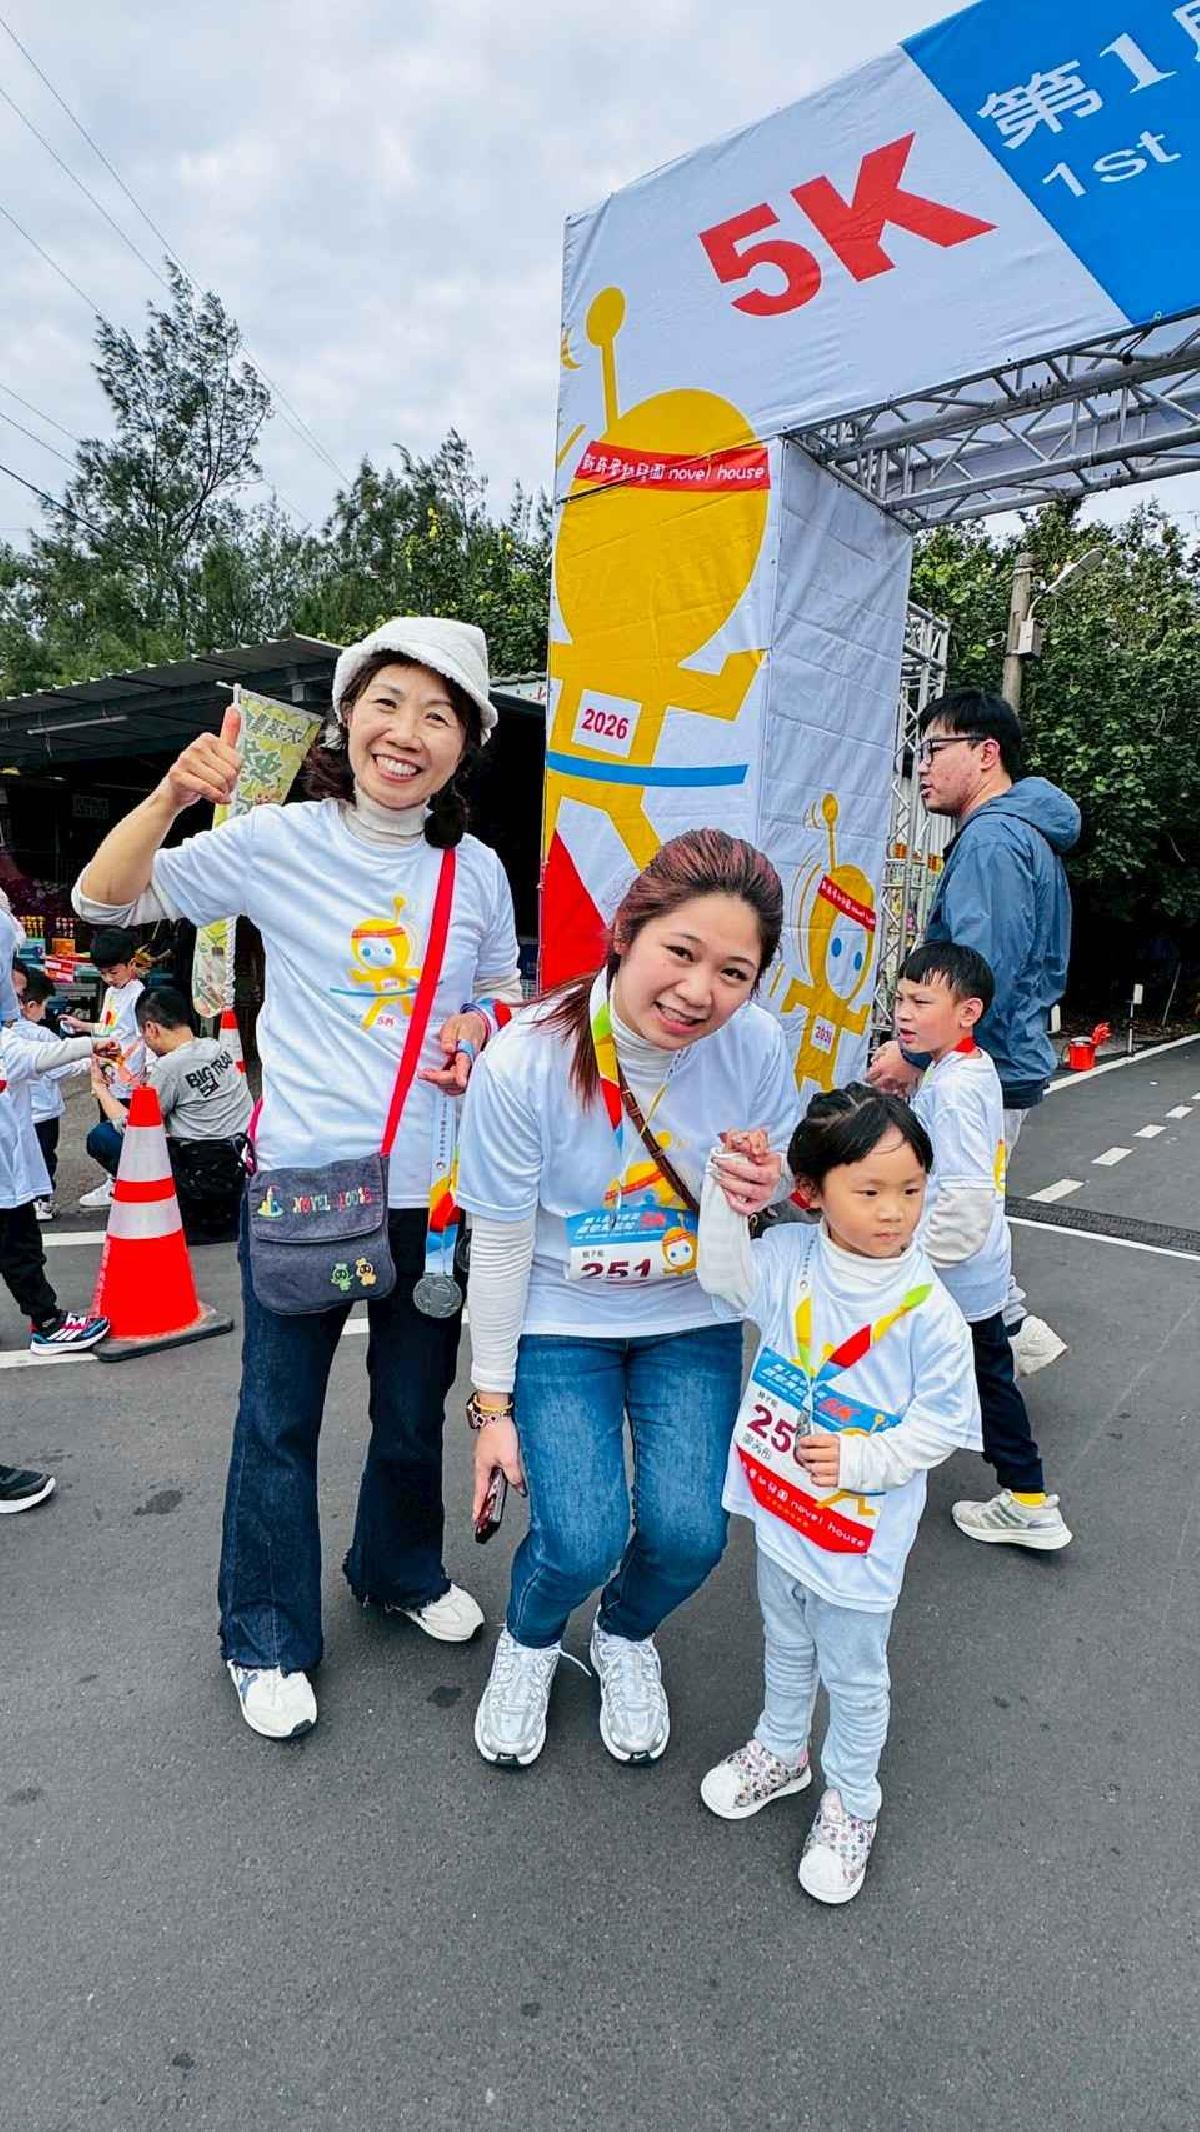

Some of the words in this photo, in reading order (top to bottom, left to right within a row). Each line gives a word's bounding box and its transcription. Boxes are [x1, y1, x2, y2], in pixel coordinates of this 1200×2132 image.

[1042, 131, 1182, 197] 1st
[697, 130, 998, 316] 5K
[668, 459, 711, 482] novel
[717, 464, 764, 479] house
[581, 708, 629, 739] 2026
[185, 1066, 217, 1089] BIG
[581, 1259, 651, 1279] 251
[747, 1404, 804, 1467] 25
[827, 1521, 866, 1548] house
